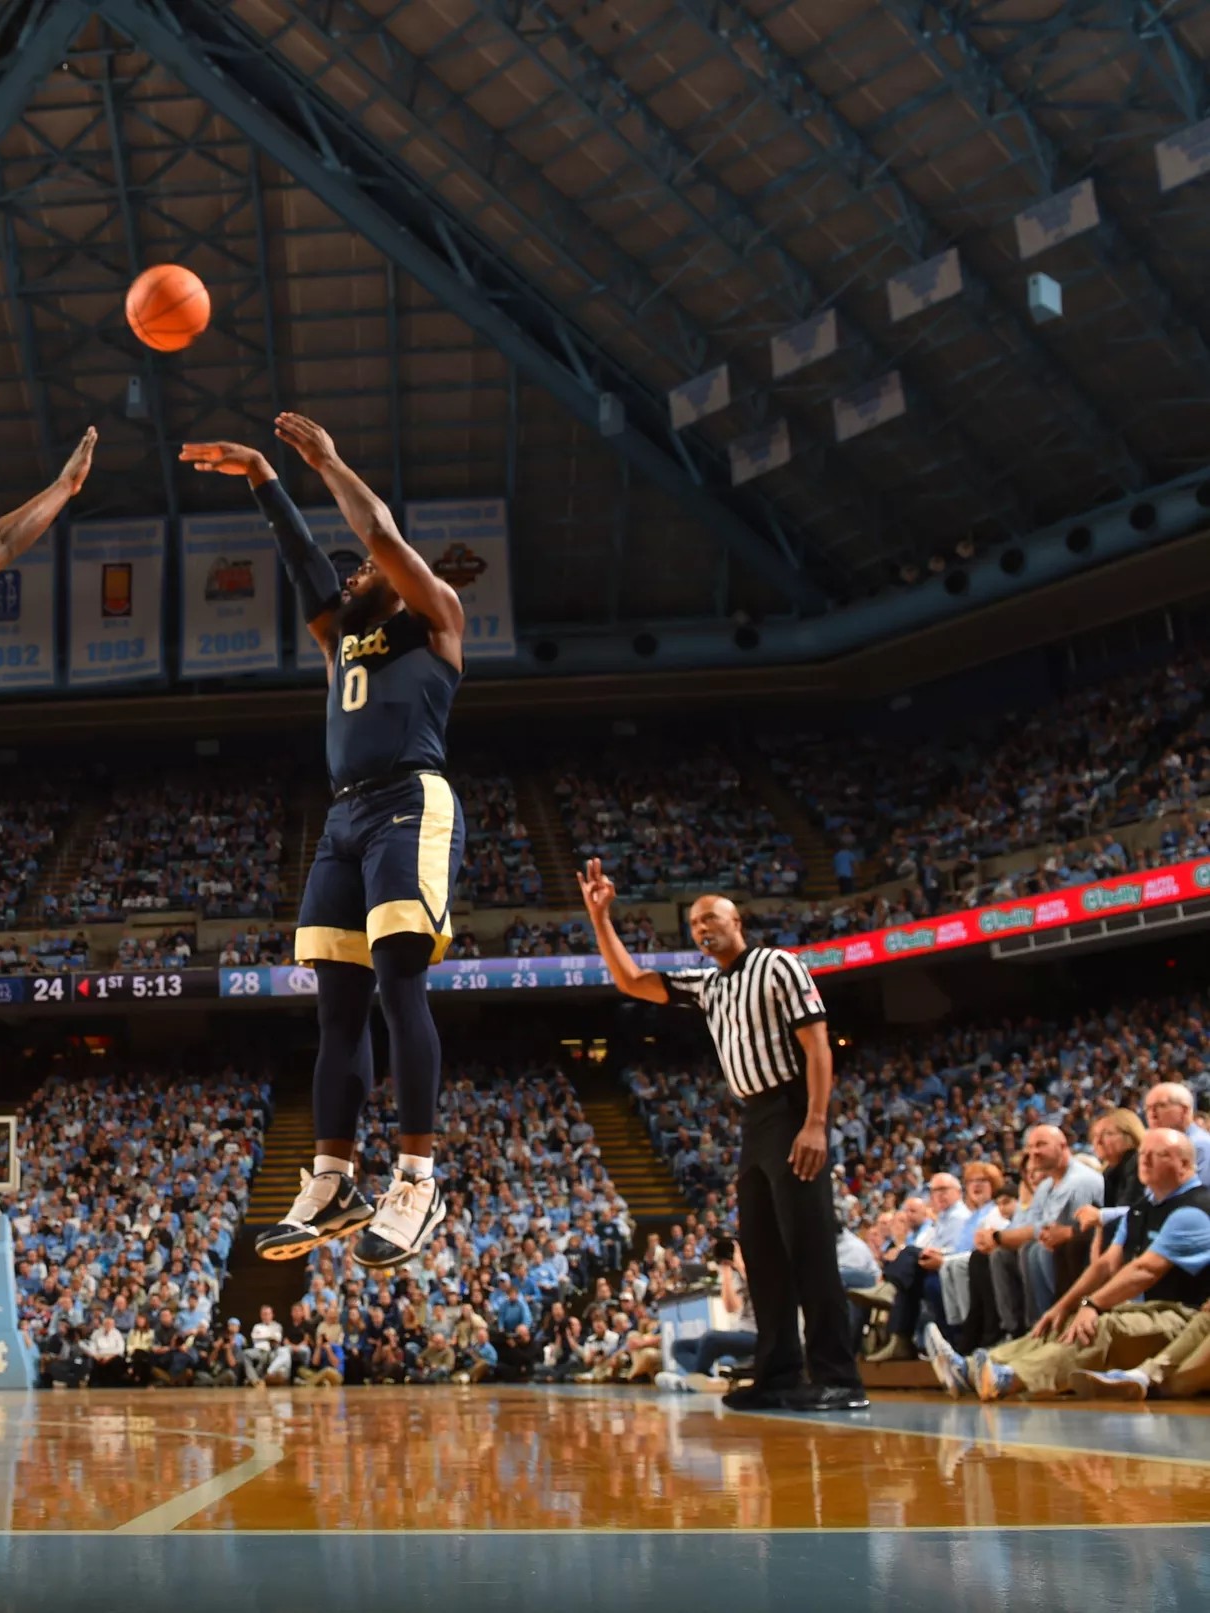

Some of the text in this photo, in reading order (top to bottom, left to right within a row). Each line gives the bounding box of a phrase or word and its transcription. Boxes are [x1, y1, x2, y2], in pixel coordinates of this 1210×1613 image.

[471, 616, 499, 637] 17
[342, 665, 368, 712] 0
[96, 975, 182, 998] 1ST 5:13
[228, 972, 260, 994] 28
[452, 974, 487, 989] 2-10
[512, 973, 537, 988] 2-3
[565, 971, 584, 985] 16
[33, 978, 64, 1000] 24
